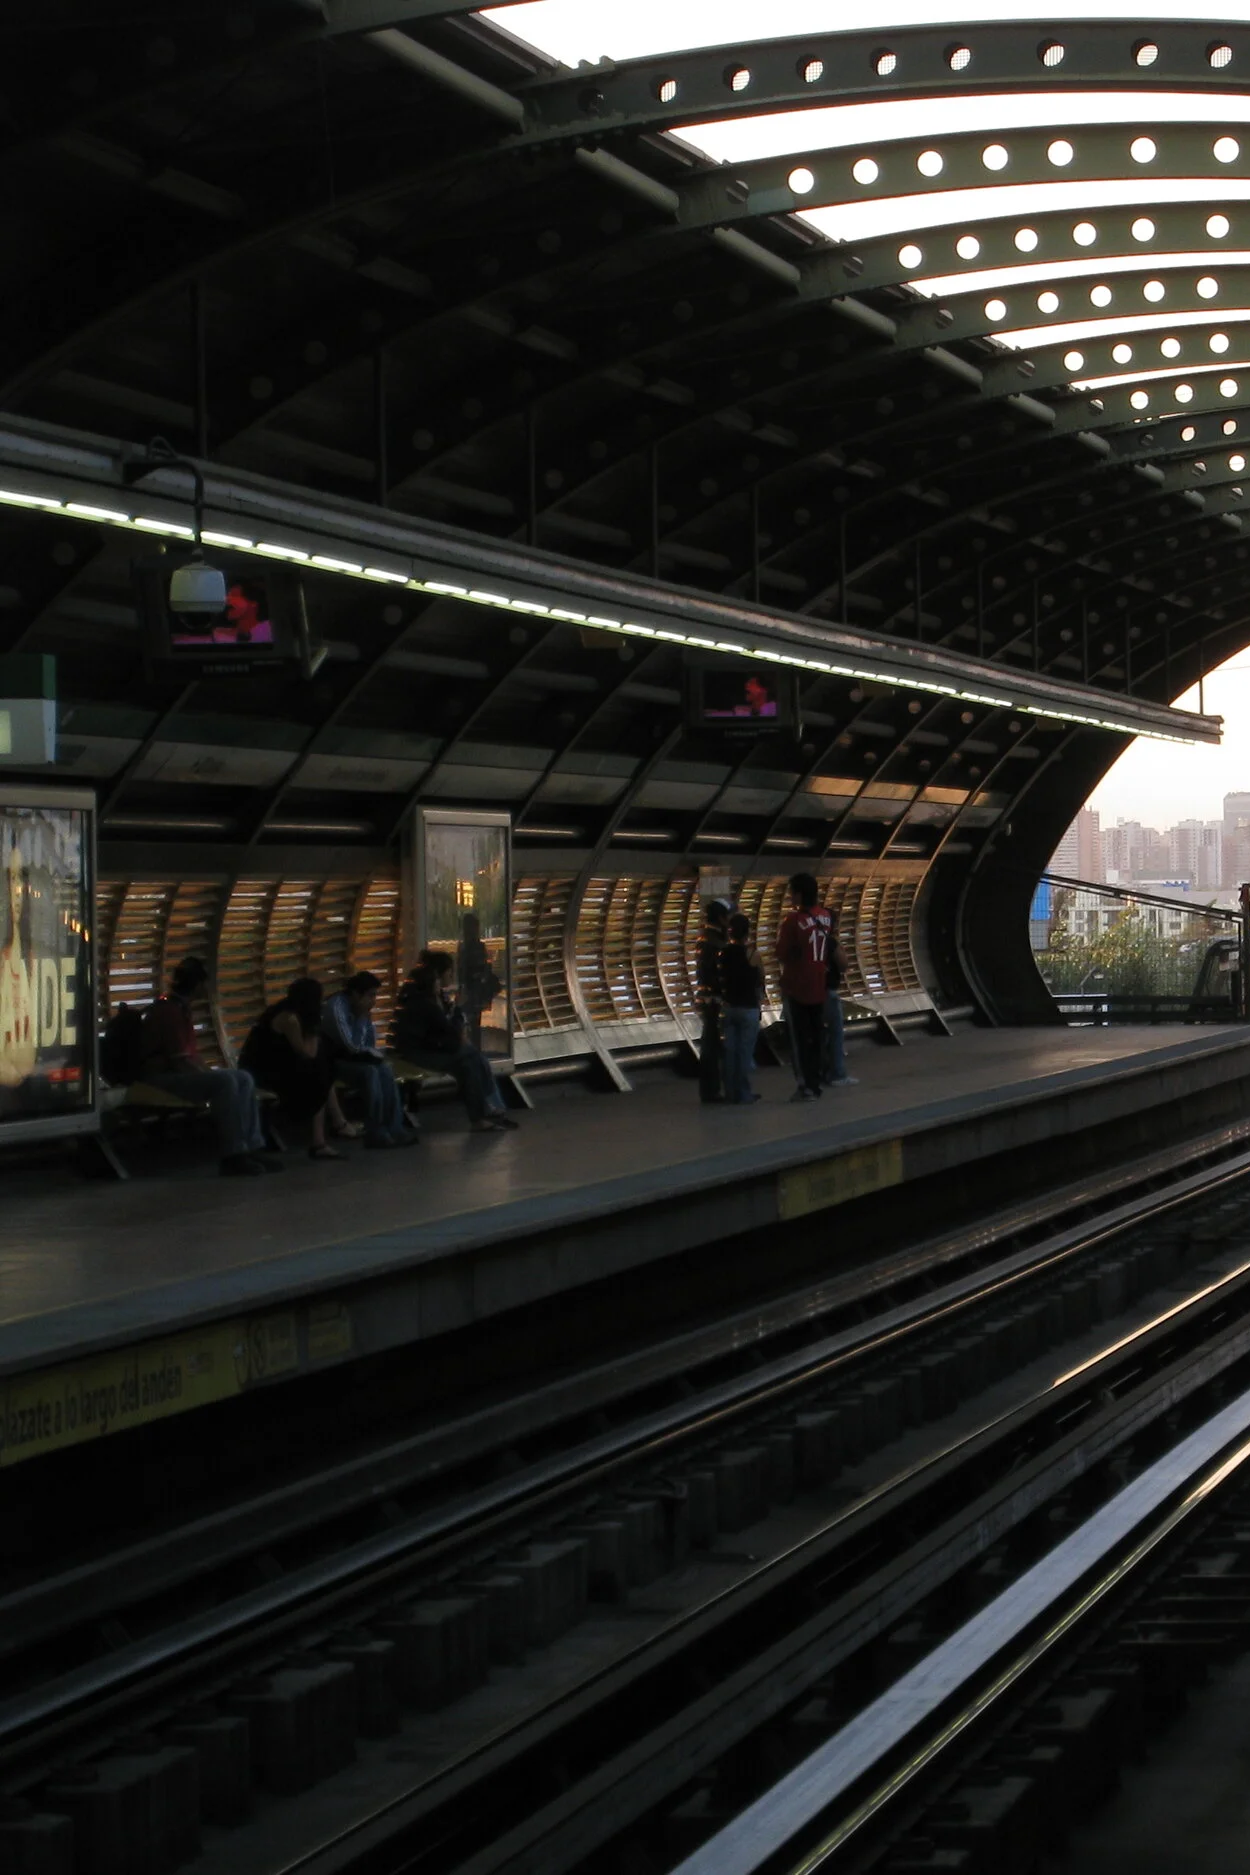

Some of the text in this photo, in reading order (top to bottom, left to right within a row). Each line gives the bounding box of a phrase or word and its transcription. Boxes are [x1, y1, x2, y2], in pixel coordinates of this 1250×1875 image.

[808, 930, 827, 962] 17
[54, 1401, 62, 1434] a
[65, 1383, 78, 1431] lo
[80, 1379, 118, 1434] largo
[119, 1362, 140, 1414] del
[141, 1353, 183, 1407] andén
